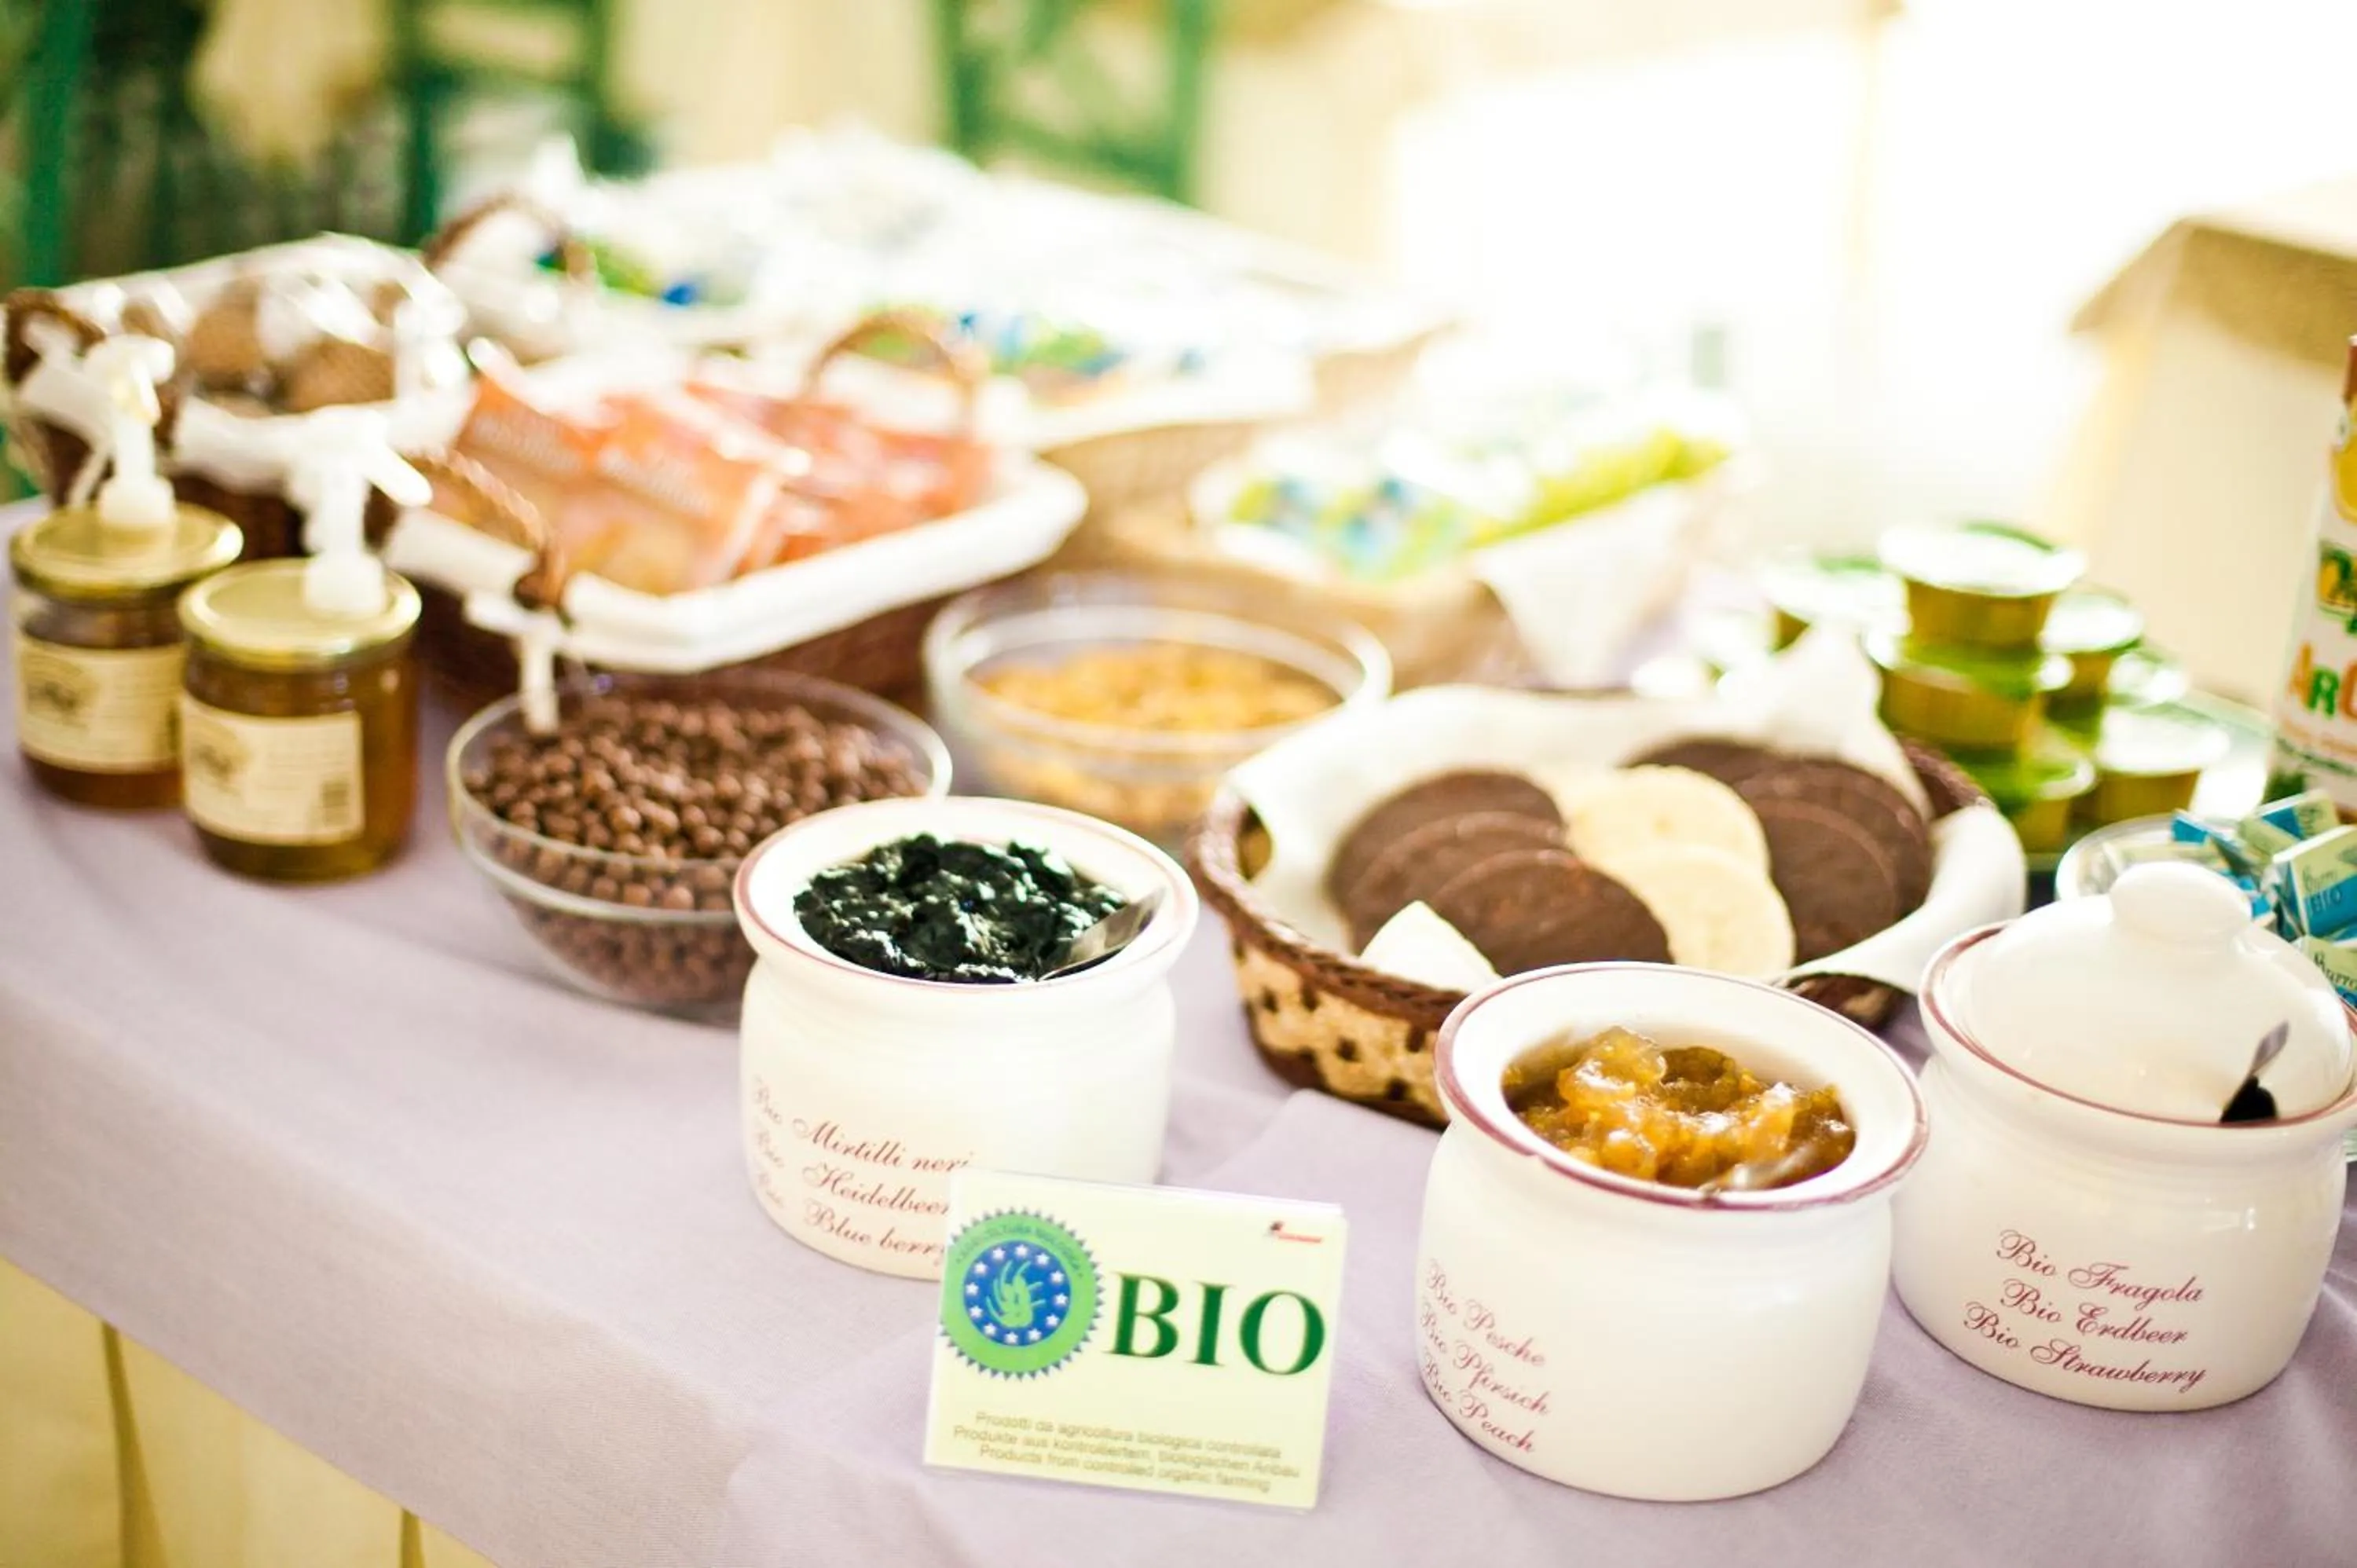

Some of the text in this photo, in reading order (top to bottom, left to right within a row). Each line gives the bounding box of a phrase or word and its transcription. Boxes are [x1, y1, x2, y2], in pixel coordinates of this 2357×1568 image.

[792, 1118, 907, 1168] Mirtilli
[804, 1197, 871, 1247] Blue
[1996, 1229, 2205, 1311] Bio Fragola
[1102, 1271, 1325, 1376] BIO
[1427, 1258, 1546, 1366] Bio Pesche
[2000, 1278, 2189, 1344] Bio Erdbeer
[1453, 1339, 1551, 1415] Pfirsich
[1963, 1301, 2207, 1394] Bio Strawberry
[953, 1424, 1018, 1445] Produkte
[1459, 1388, 1535, 1453] Peach
